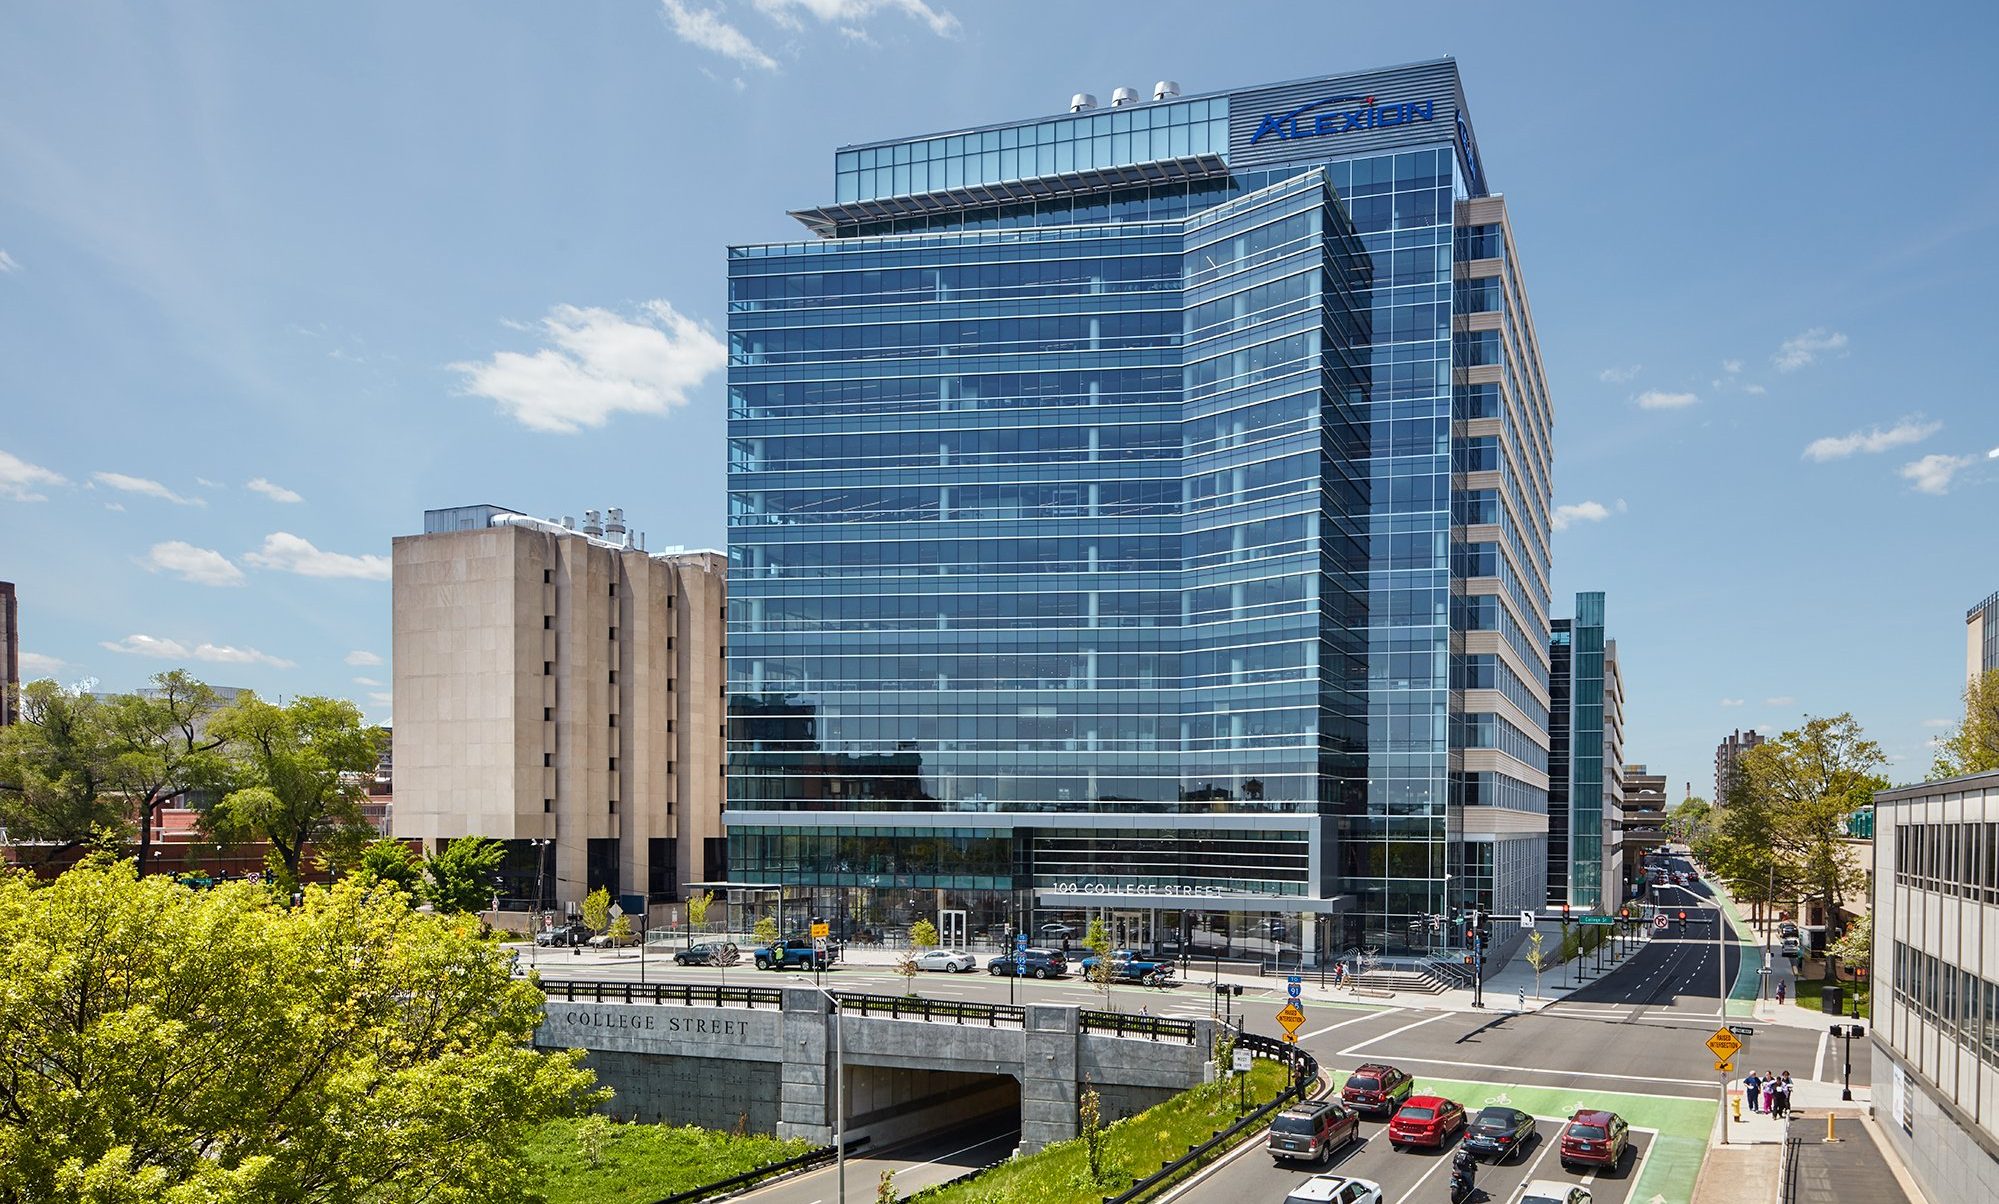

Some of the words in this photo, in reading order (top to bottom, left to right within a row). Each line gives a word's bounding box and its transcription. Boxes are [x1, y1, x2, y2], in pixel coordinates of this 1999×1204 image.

[1251, 97, 1433, 145] ALEXION
[1053, 882, 1077, 894] 100
[1084, 883, 1156, 895] COLLEGE
[1164, 885, 1223, 898] STREET
[1290, 987, 1299, 995] 91
[567, 1011, 655, 1030] COLLEGE
[669, 1017, 749, 1035] STREET
[1279, 1015, 1303, 1023] INTERSECTION
[1716, 1034, 1731, 1042] RAISED
